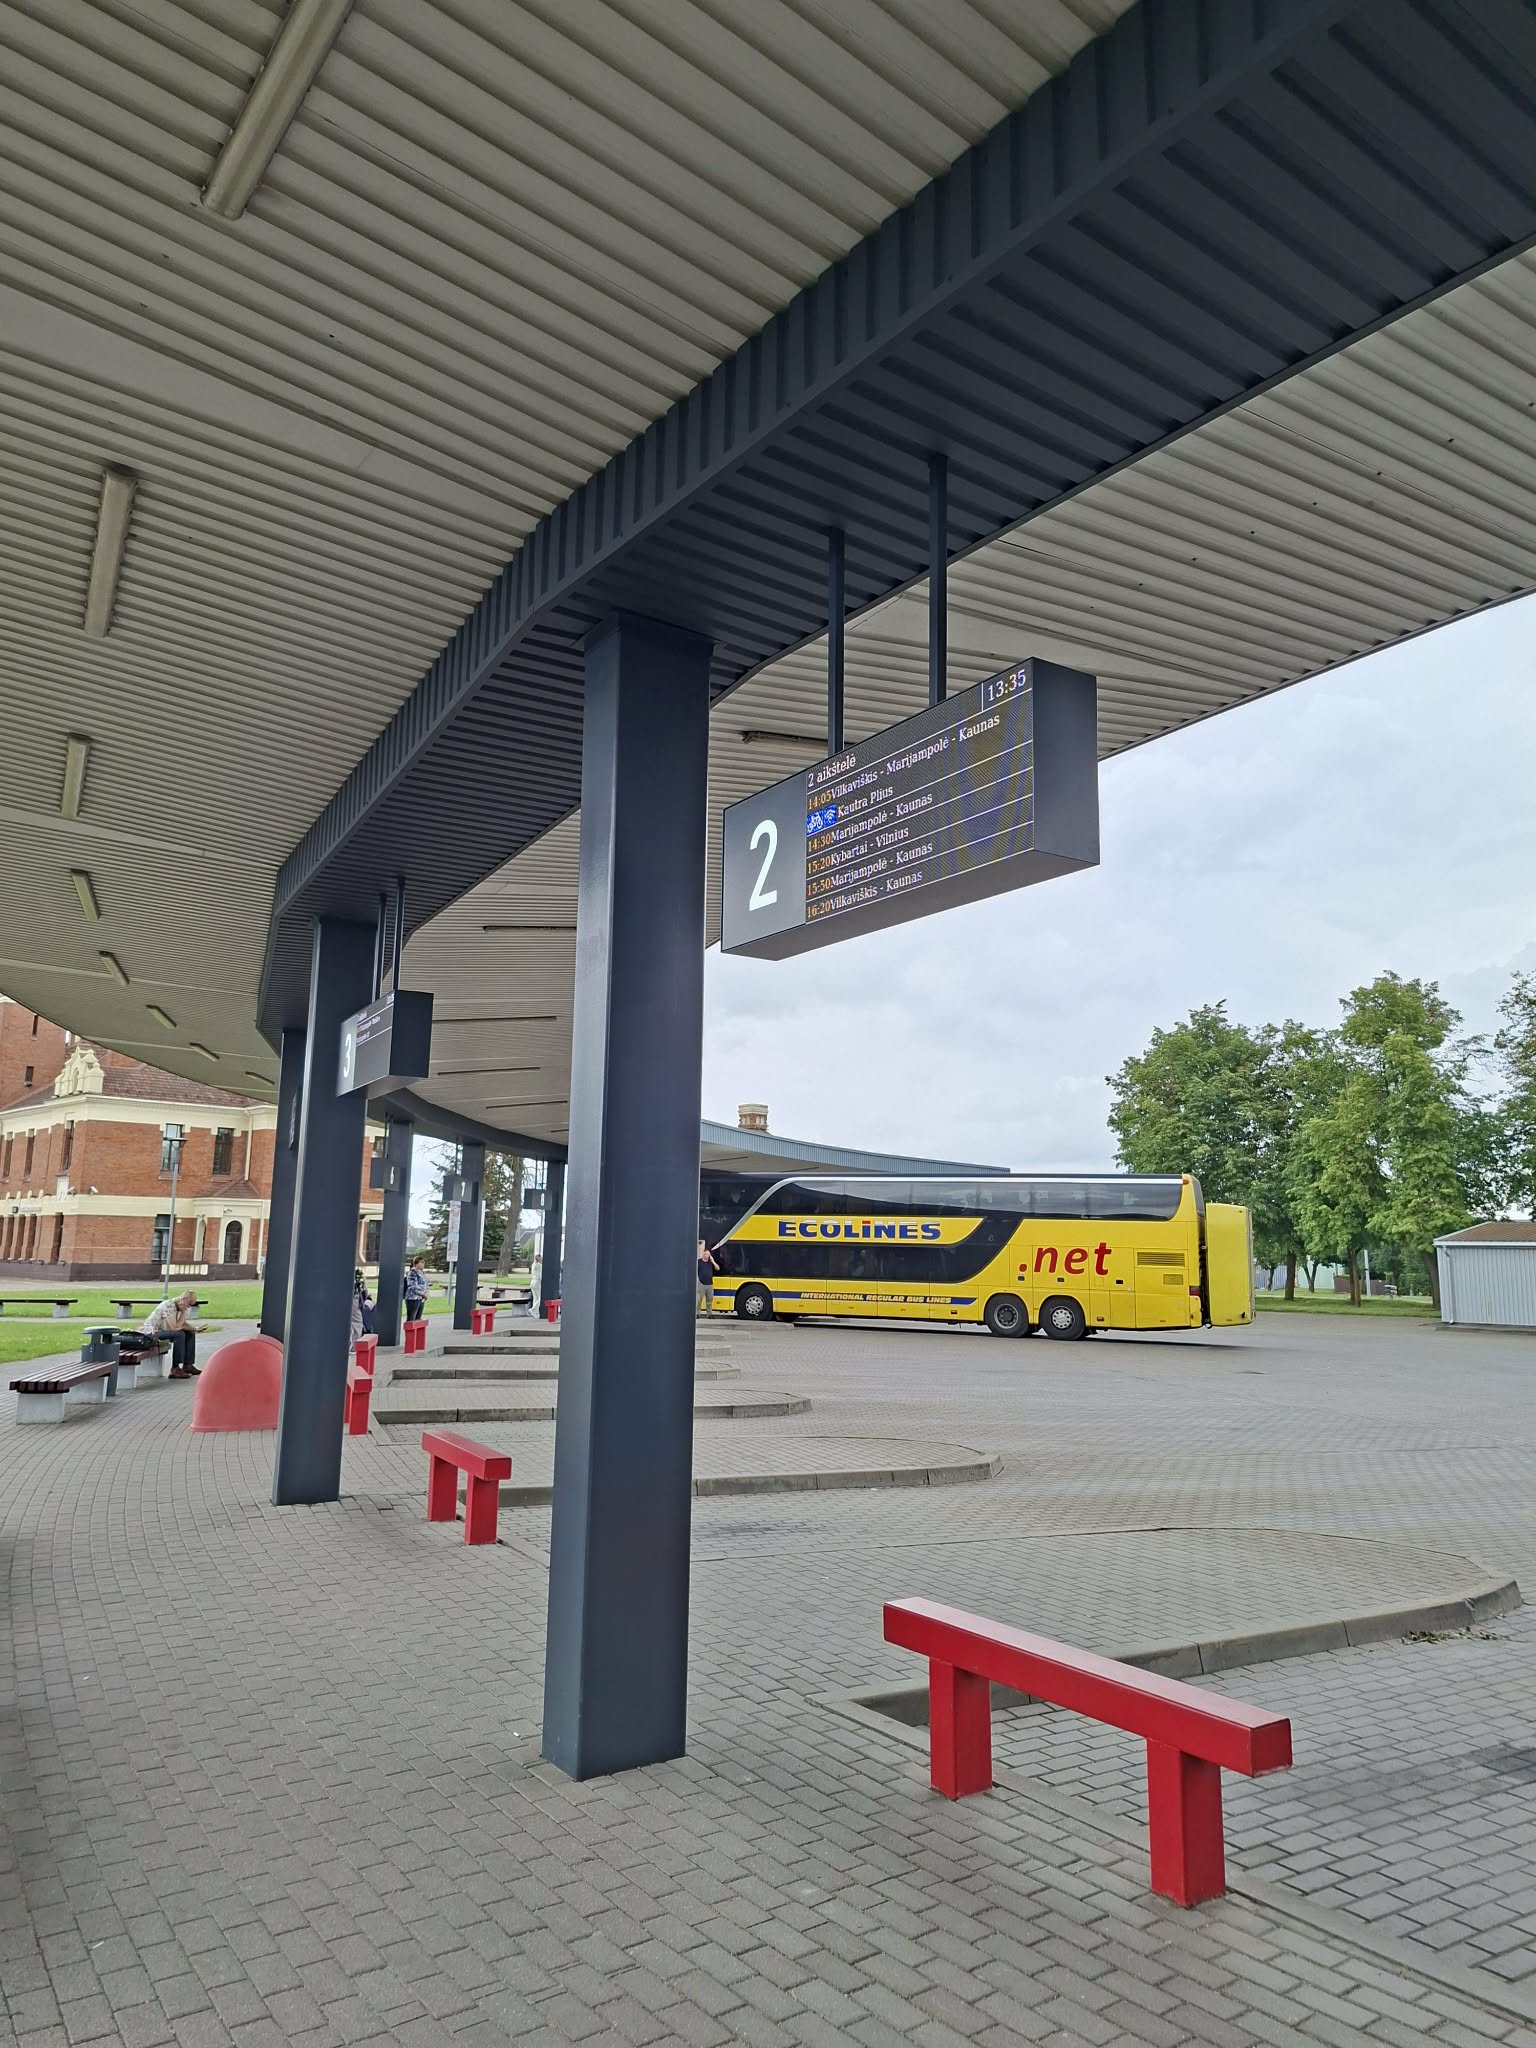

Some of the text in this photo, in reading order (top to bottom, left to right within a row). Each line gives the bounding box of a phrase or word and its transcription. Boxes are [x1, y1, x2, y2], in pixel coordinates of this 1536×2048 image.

[988, 669, 1026, 701] 13:35
[886, 737, 949, 775] Marijampolė
[959, 714, 1000, 742] Kaunas
[808, 754, 856, 787] 2 aikštelė
[831, 810, 888, 842] Marijampolė
[896, 793, 933, 817] Kaunas
[837, 786, 894, 818] Kautra Plius
[748, 818, 778, 911] 2
[830, 841, 868, 866] Kybartai
[876, 827, 909, 848] Vilnius
[830, 858, 888, 888] Marijampolė
[895, 843, 933, 865] Kaunas
[886, 871, 923, 892] Kaunas
[343, 1033, 352, 1078] 3
[1018, 1242, 1112, 1276] .net
[800, 1292, 952, 1304] INTERNATIONAL REGULAR BUS LINES
